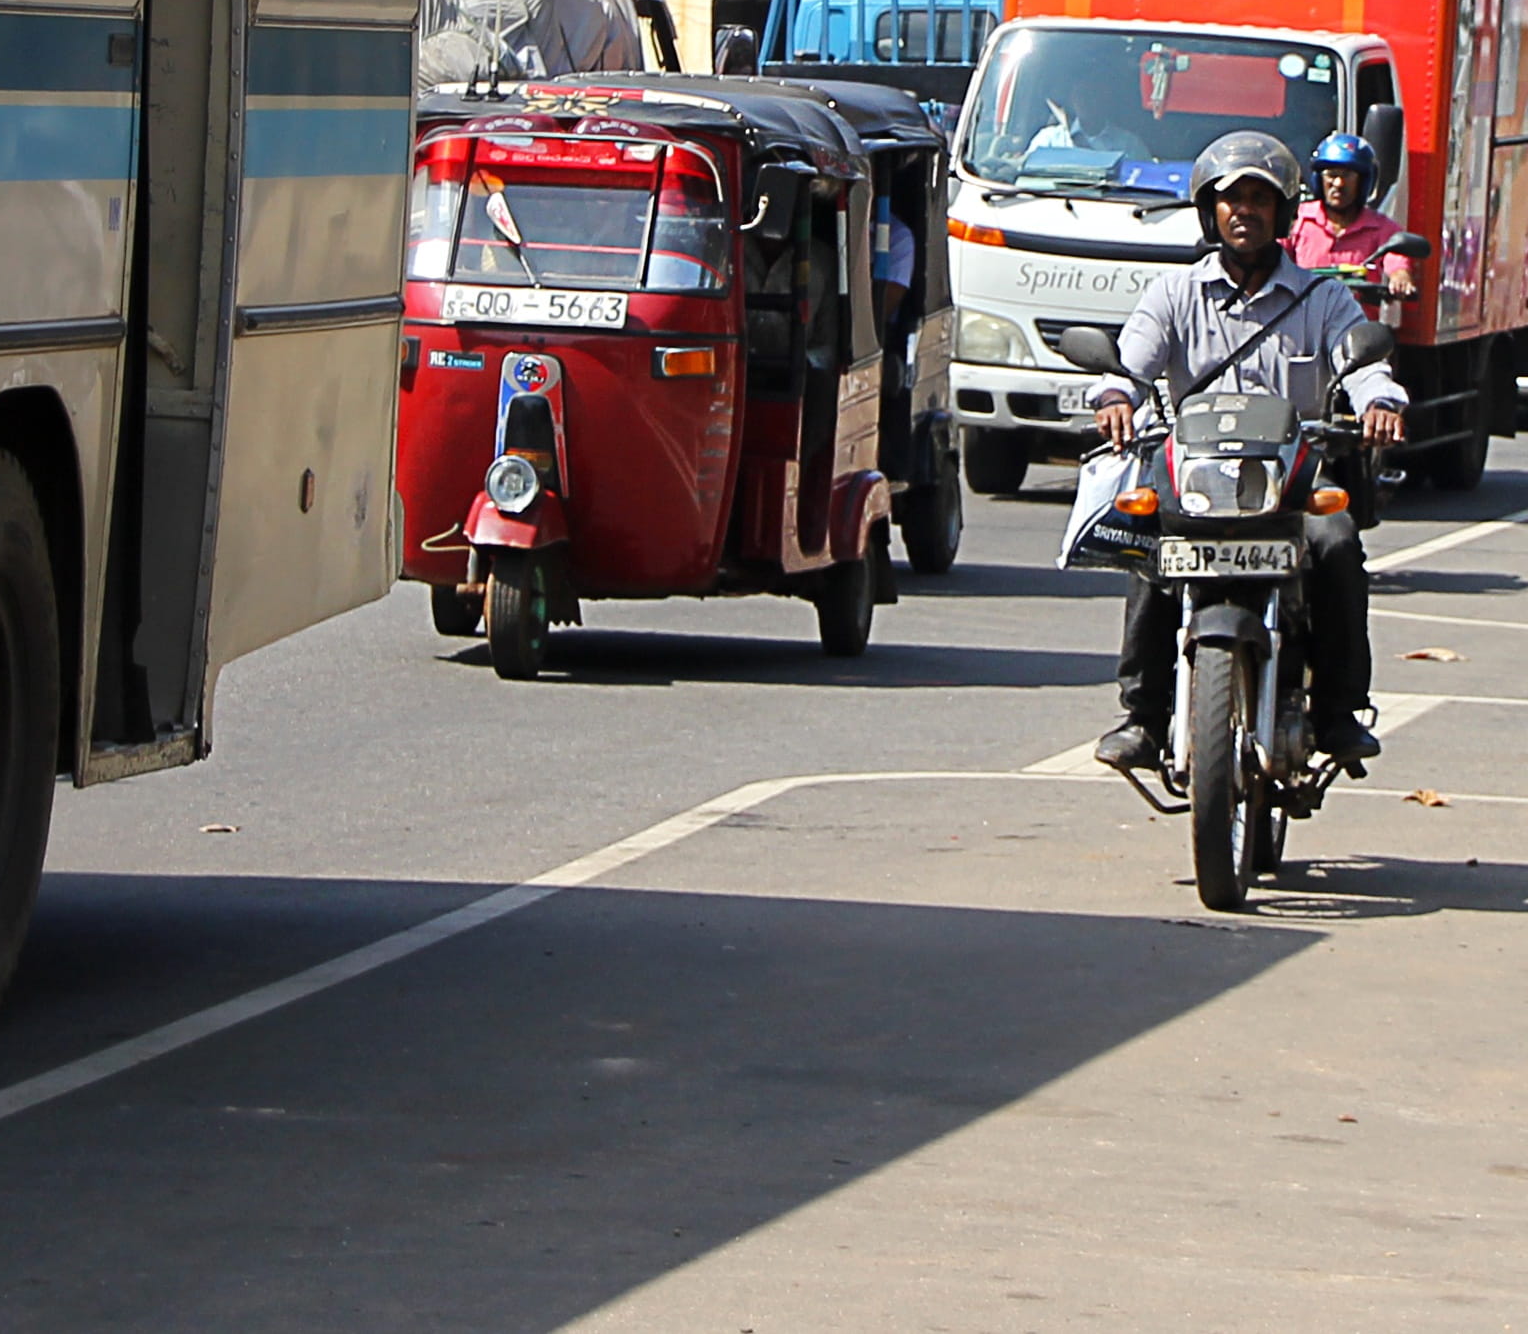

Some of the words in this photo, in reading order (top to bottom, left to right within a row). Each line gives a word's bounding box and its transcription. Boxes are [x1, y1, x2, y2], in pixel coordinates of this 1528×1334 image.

[1016, 262, 1083, 295] Spirit
[1092, 267, 1122, 293] of
[1125, 269, 1162, 294] Sr
